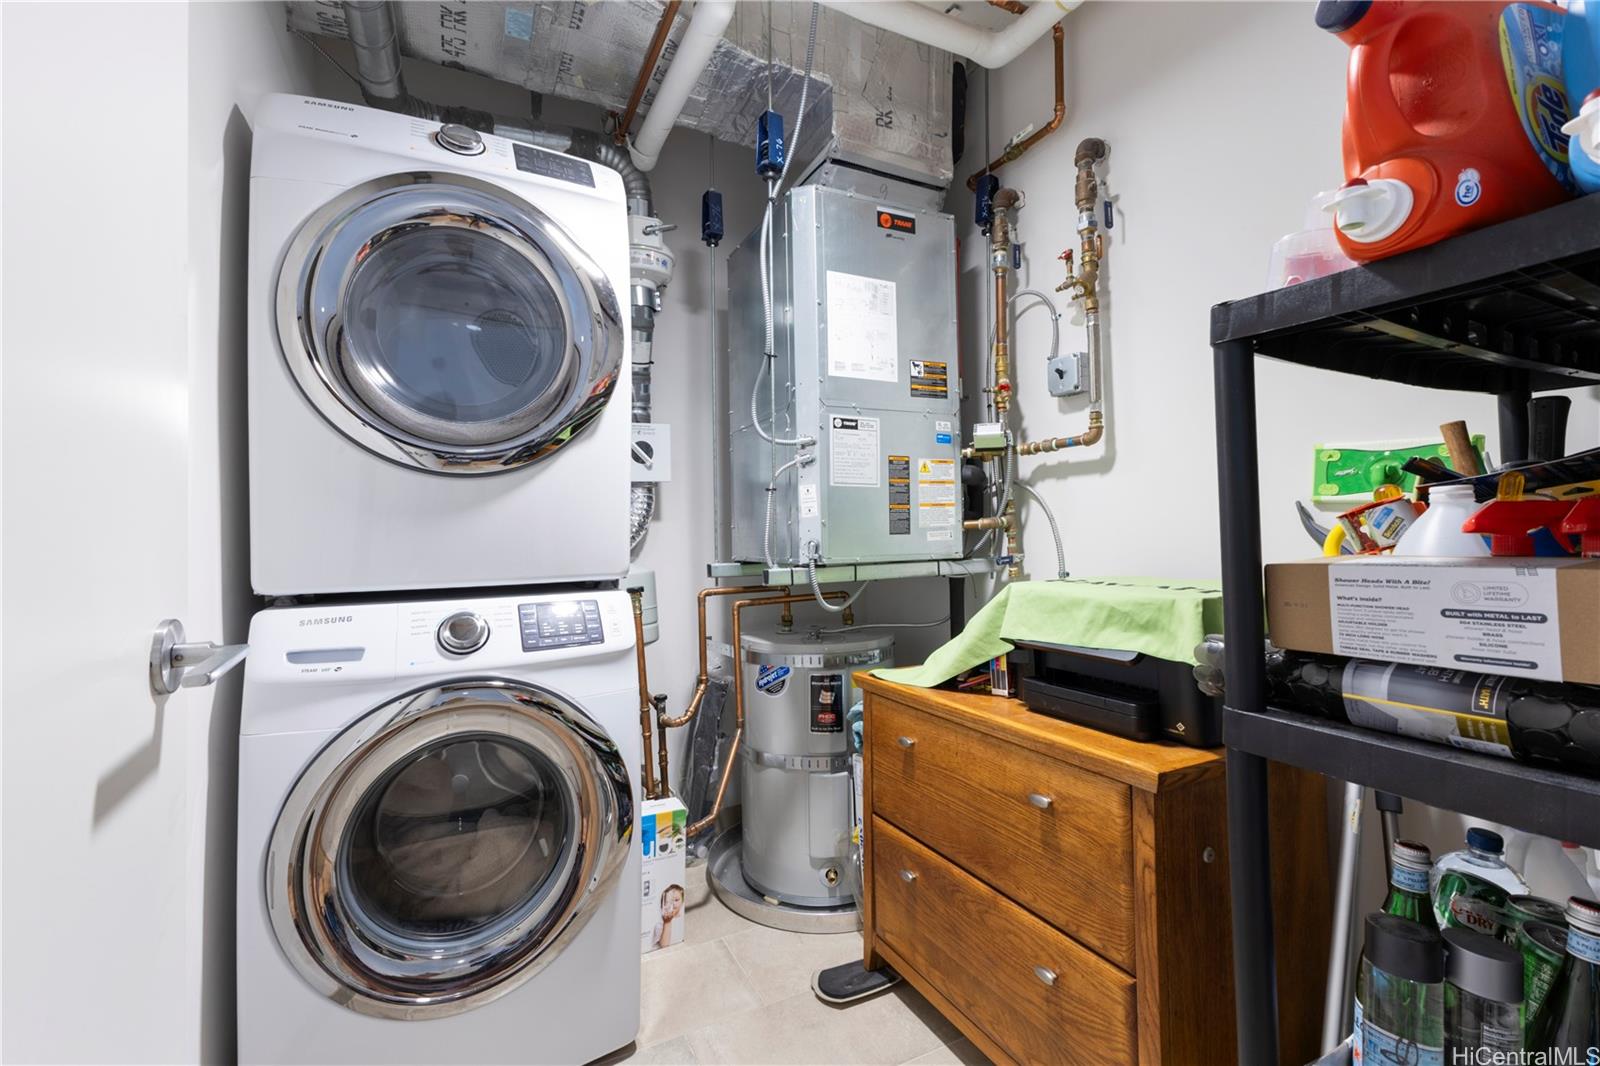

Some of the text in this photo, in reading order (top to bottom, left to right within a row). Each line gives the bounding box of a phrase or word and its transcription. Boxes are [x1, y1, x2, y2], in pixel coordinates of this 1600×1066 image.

[304, 100, 355, 112] SAMSUNG
[1536, 83, 1570, 158] Tide
[1462, 183, 1473, 200] he
[1383, 517, 1403, 539] Scotch
[299, 615, 353, 627] SAMSUNG
[1467, 914, 1495, 931] DRY
